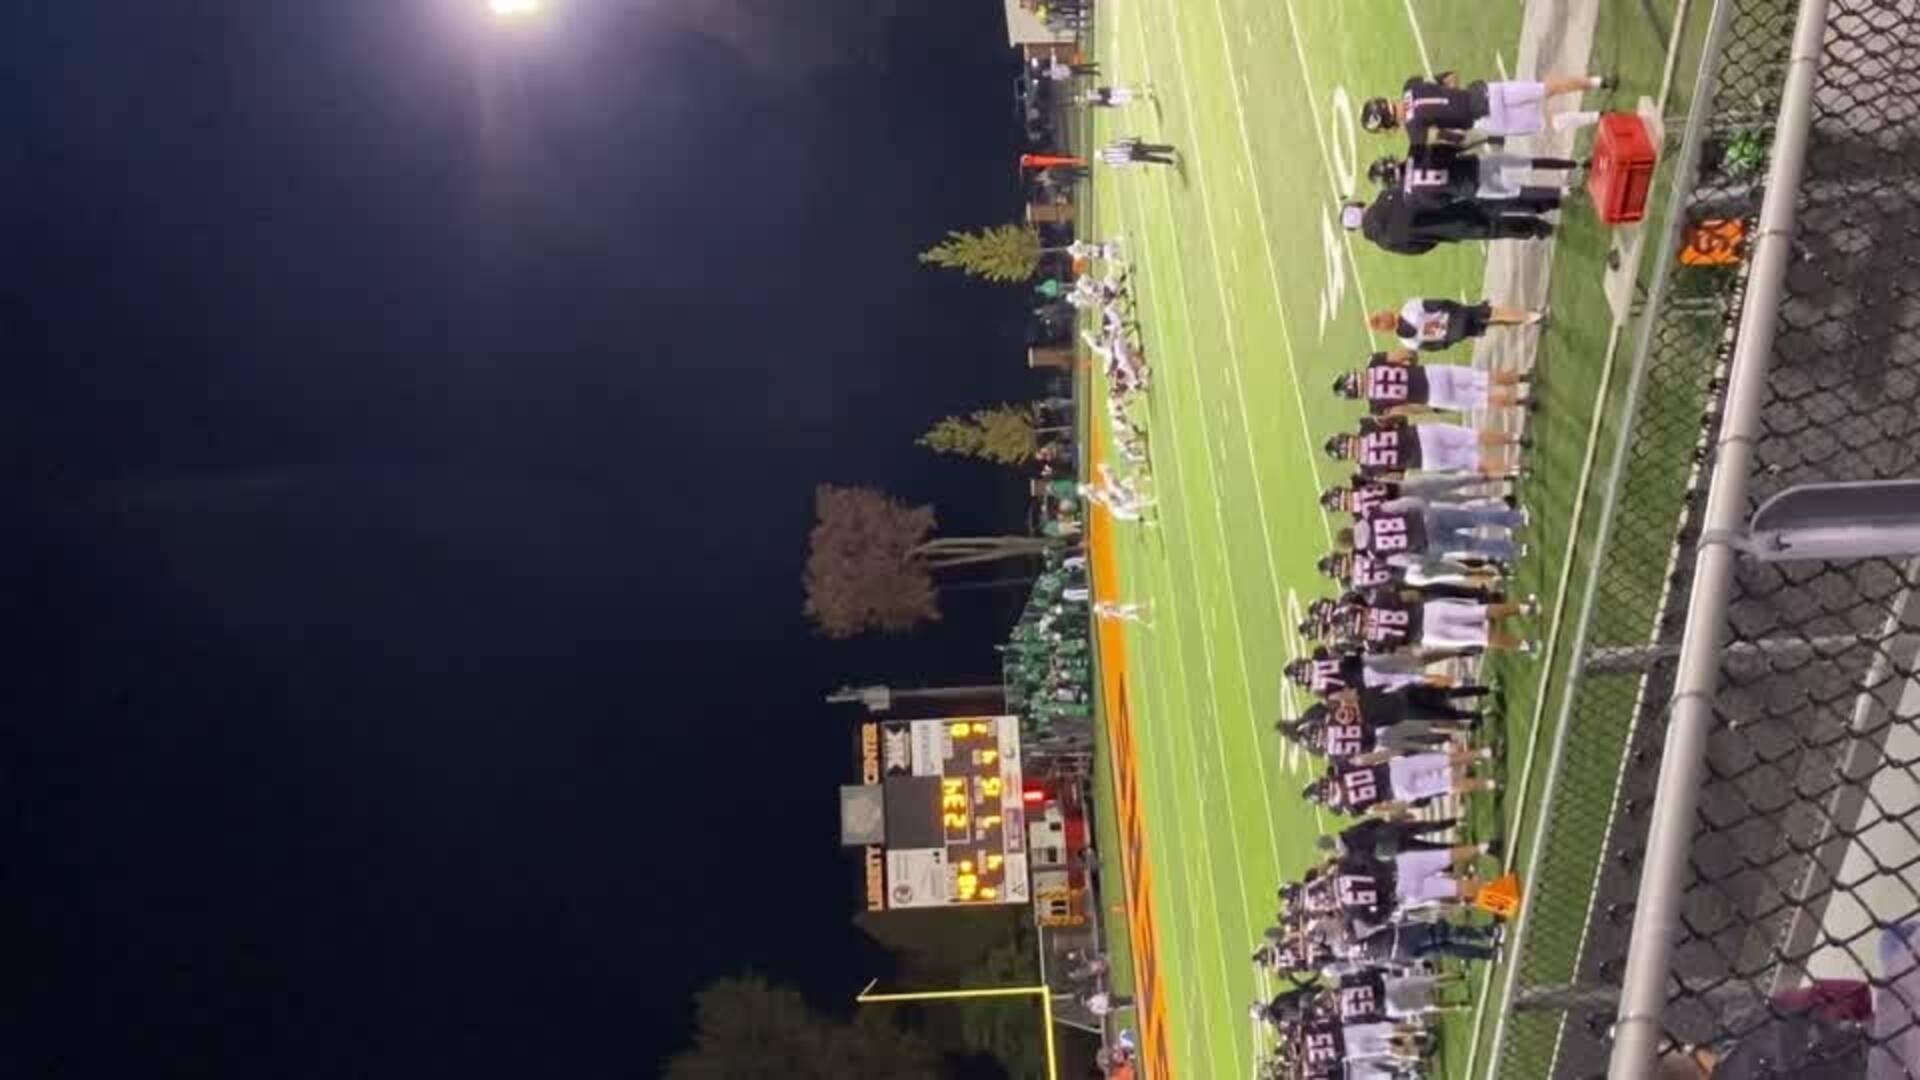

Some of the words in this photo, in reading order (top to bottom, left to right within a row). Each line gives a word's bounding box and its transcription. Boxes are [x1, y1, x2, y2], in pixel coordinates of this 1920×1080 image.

[1412, 168, 1449, 186] 6
[1375, 366, 1409, 400] 63
[1369, 431, 1399, 466] 55
[1375, 517, 1408, 550] 88
[1377, 609, 1409, 641] 78
[1316, 659, 1345, 689] 70
[1335, 725, 1362, 755] 56
[1344, 768, 1377, 804] 60
[1343, 875, 1377, 905] 67
[1343, 985, 1374, 1018] 53
[1307, 1032, 1335, 1062] 35
